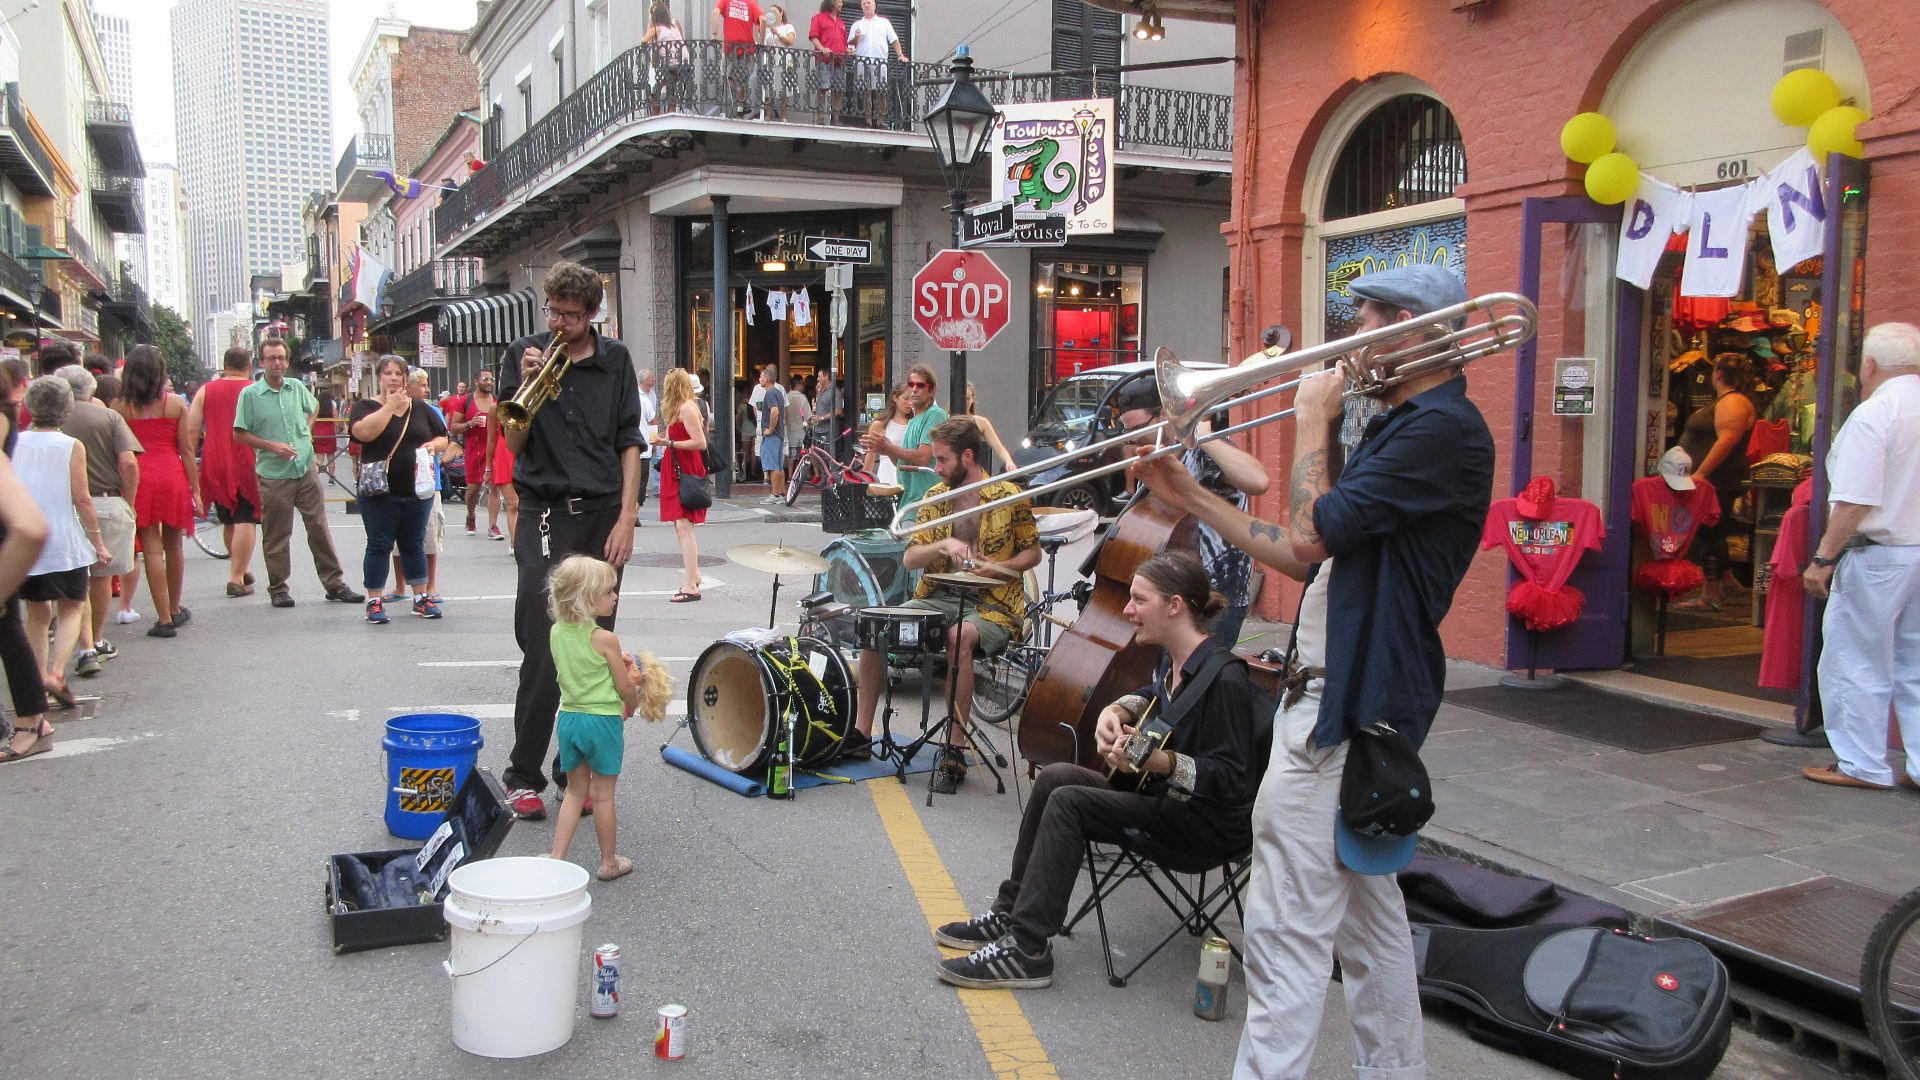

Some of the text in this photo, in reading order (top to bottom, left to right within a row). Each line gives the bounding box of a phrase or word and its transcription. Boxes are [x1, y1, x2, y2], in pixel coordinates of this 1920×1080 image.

[1006, 121, 1075, 138] Toulouse
[1087, 123, 1104, 199] Royale
[1716, 159, 1749, 179] 601
[1625, 163, 1826, 259] D L N
[973, 212, 1003, 236] Royal
[1077, 220, 1089, 230] To
[1092, 218, 1108, 229] Go
[160, 179, 172, 292] HOTEL MONTELEONE
[778, 234, 798, 246] 541
[754, 250, 778, 263] Rue
[825, 245, 843, 256] ONE
[919, 281, 1003, 319] STOP
[1511, 526, 1529, 542] NEW
